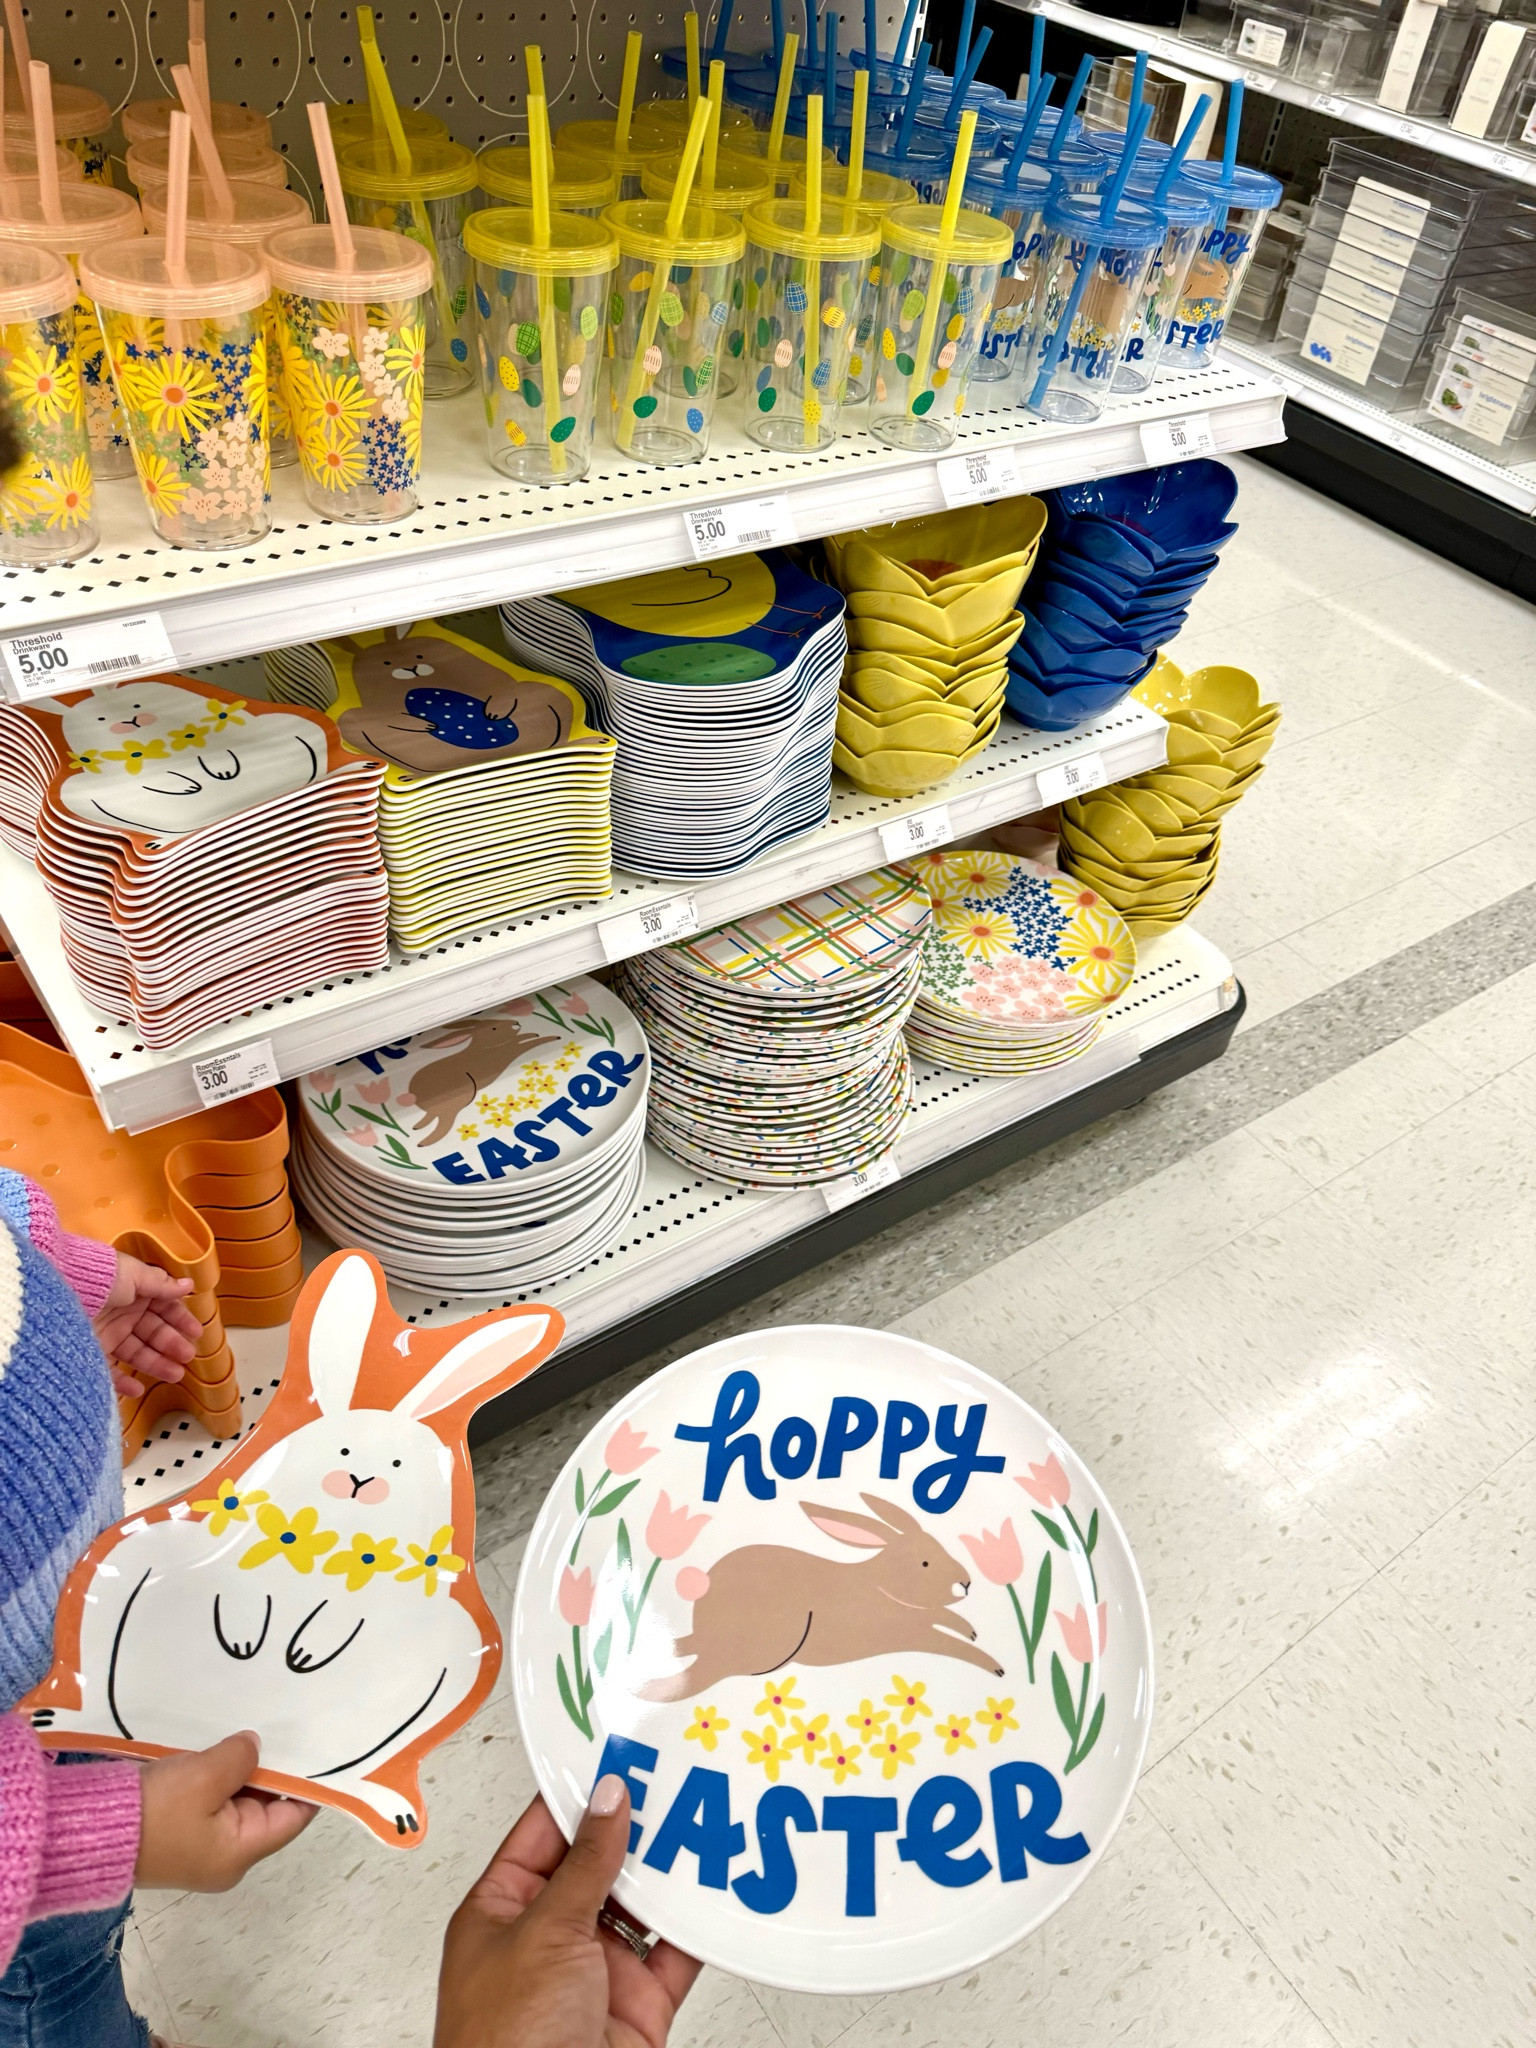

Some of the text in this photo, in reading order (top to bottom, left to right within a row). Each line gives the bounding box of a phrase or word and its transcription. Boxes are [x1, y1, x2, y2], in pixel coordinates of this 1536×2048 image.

[1171, 432, 1187, 446] 5.00
[969, 467, 988, 485] 5.00
[690, 508, 722, 520] Threshold
[694, 520, 726, 541] 5.00
[9, 632, 63, 649] Threshold
[12, 643, 51, 655] Drinkware
[18, 647, 69, 675] 5.00
[1065, 772, 1080, 786] 3.00
[909, 826, 924, 841] 3.00
[643, 917, 662, 934] 3.00
[201, 1070, 229, 1090] 3.00
[852, 1172, 868, 1187] 3.00
